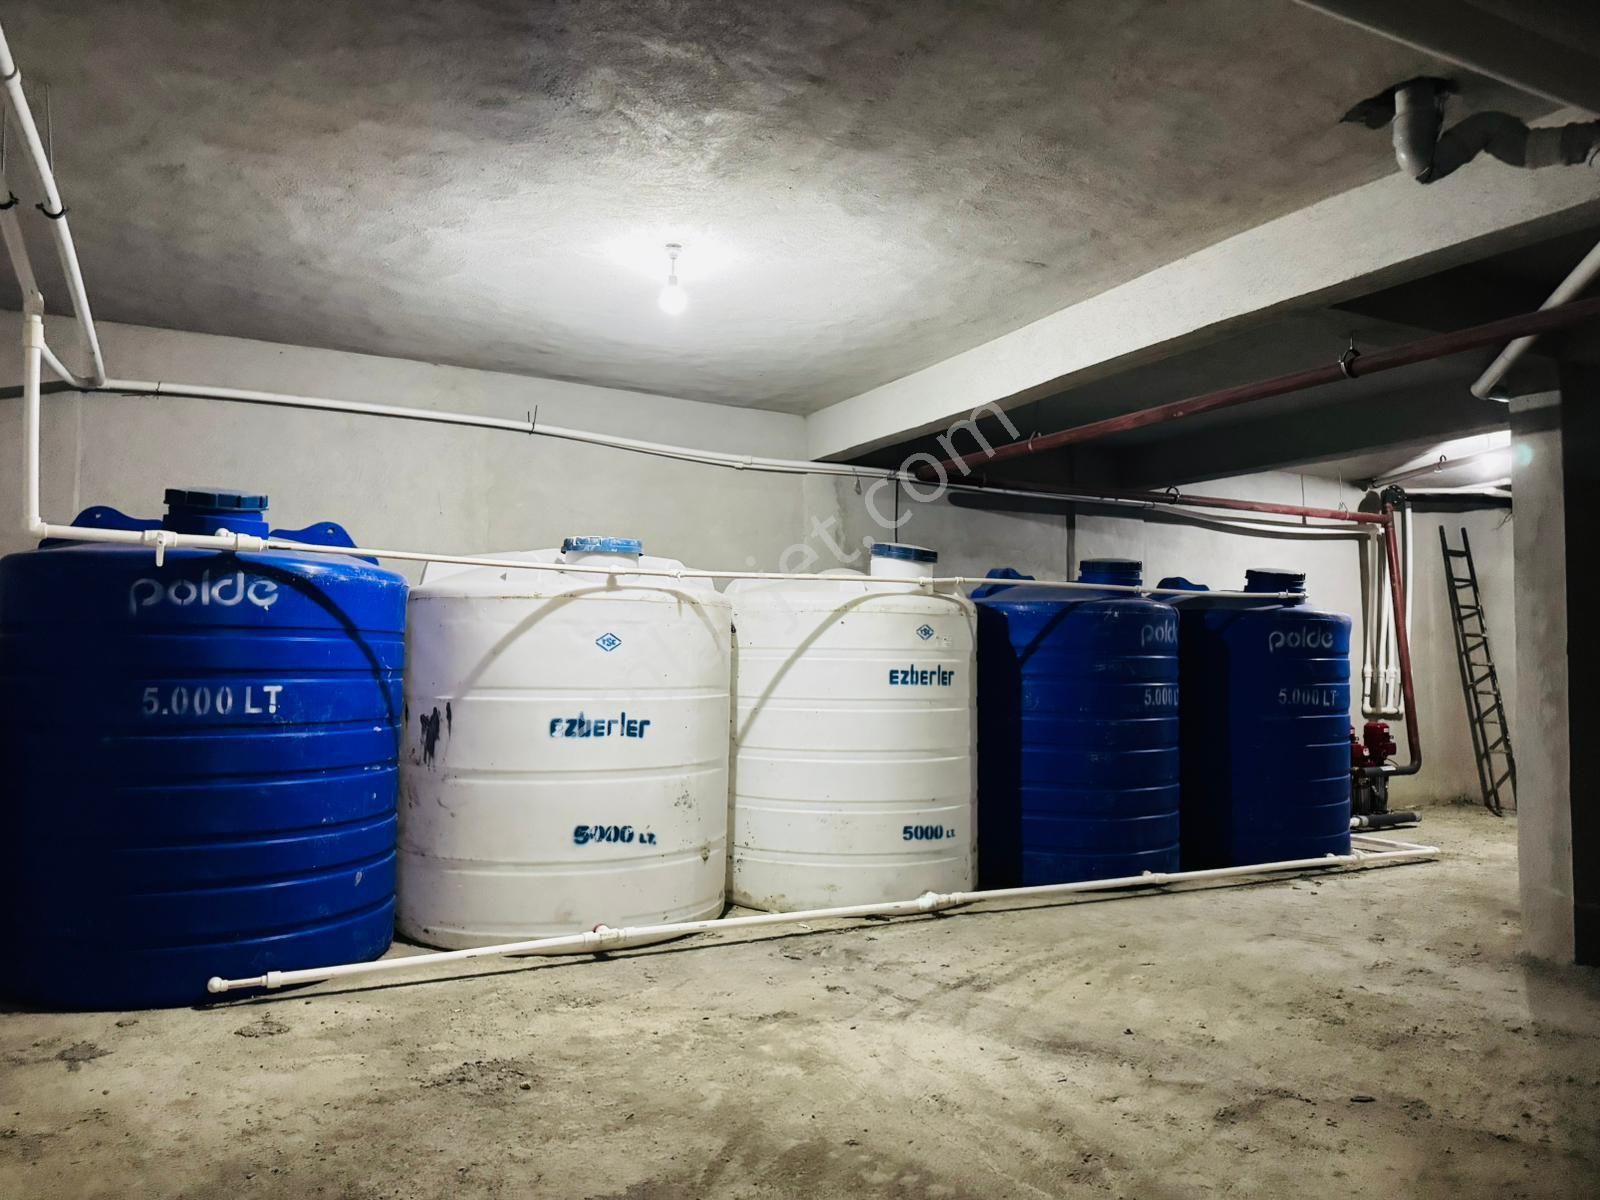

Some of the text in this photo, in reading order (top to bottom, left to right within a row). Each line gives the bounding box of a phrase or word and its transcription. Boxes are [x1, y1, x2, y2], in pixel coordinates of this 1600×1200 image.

[1142, 619, 1178, 647] pold
[1268, 626, 1334, 653] polde
[143, 685, 283, 715] 5.000 LT
[1323, 689, 1339, 706] LT
[902, 824, 944, 840] 5000
